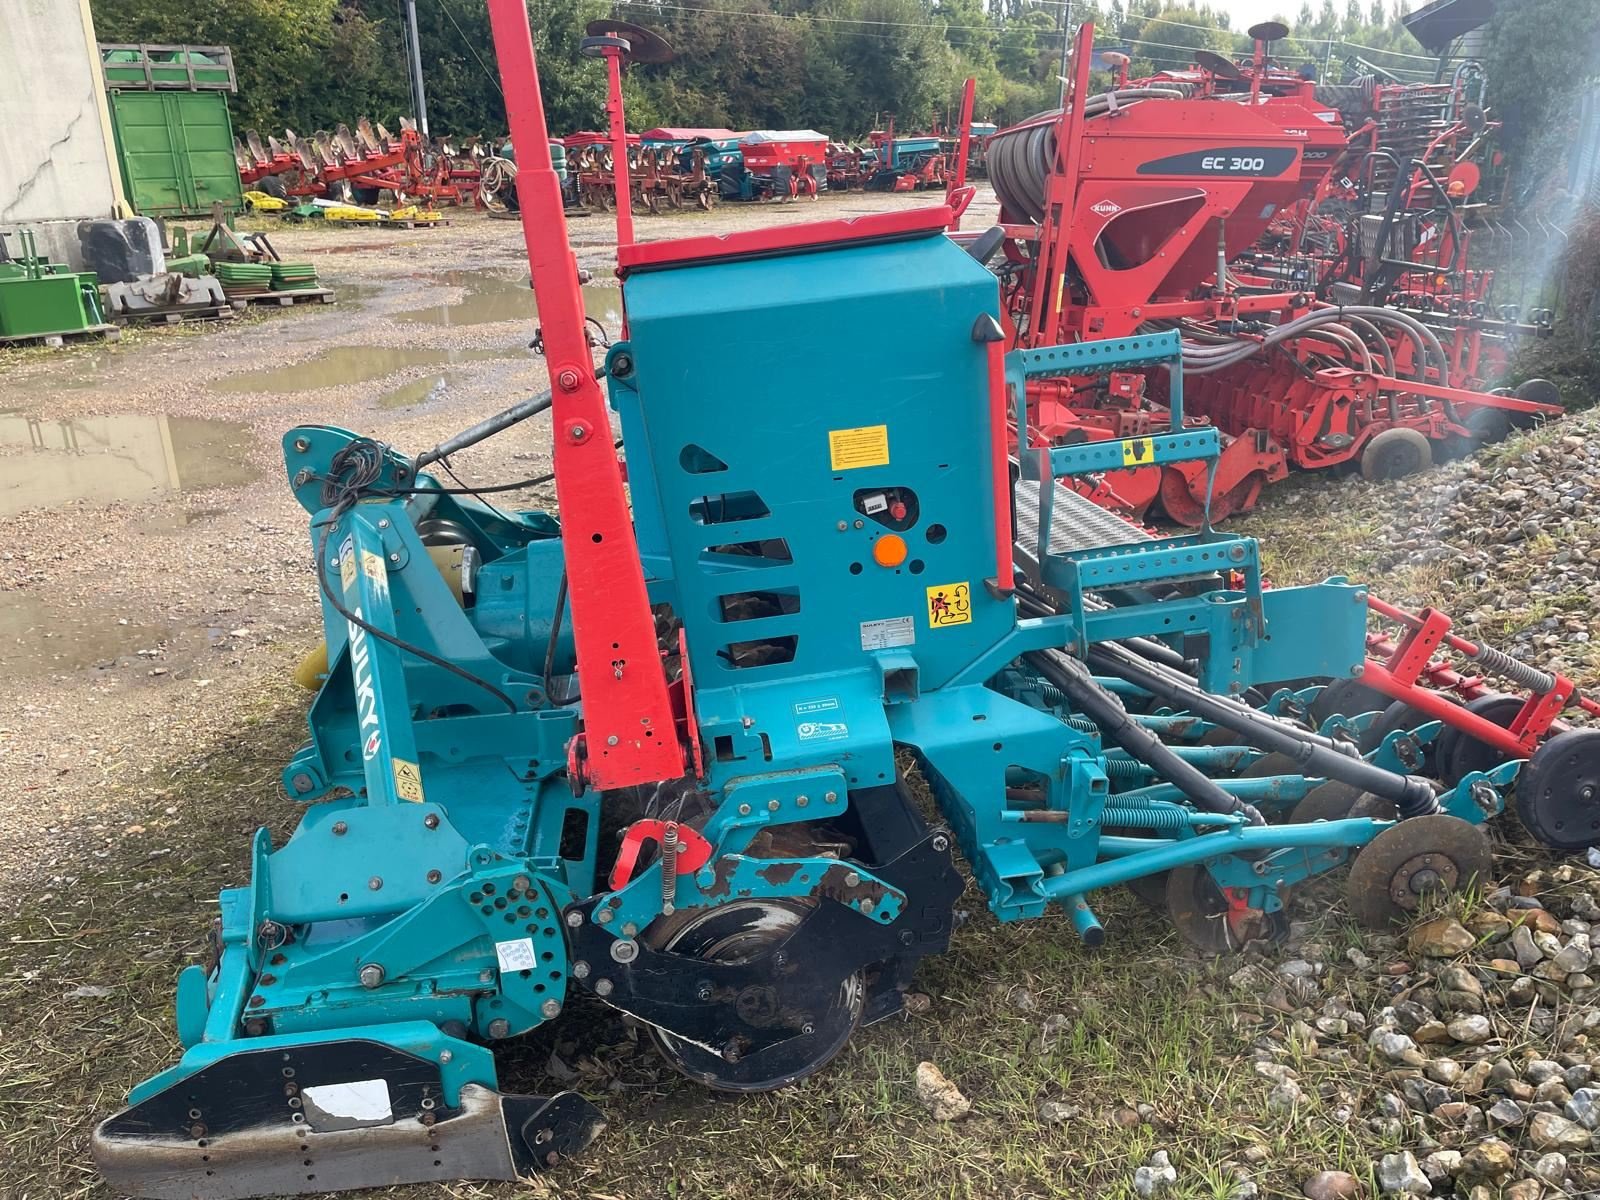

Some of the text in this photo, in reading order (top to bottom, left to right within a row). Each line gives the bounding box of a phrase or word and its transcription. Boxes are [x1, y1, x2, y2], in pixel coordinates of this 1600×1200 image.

[1201, 157, 1265, 171] EC 300
[1094, 204, 1118, 212] KUHN
[348, 606, 379, 729] SULKY
